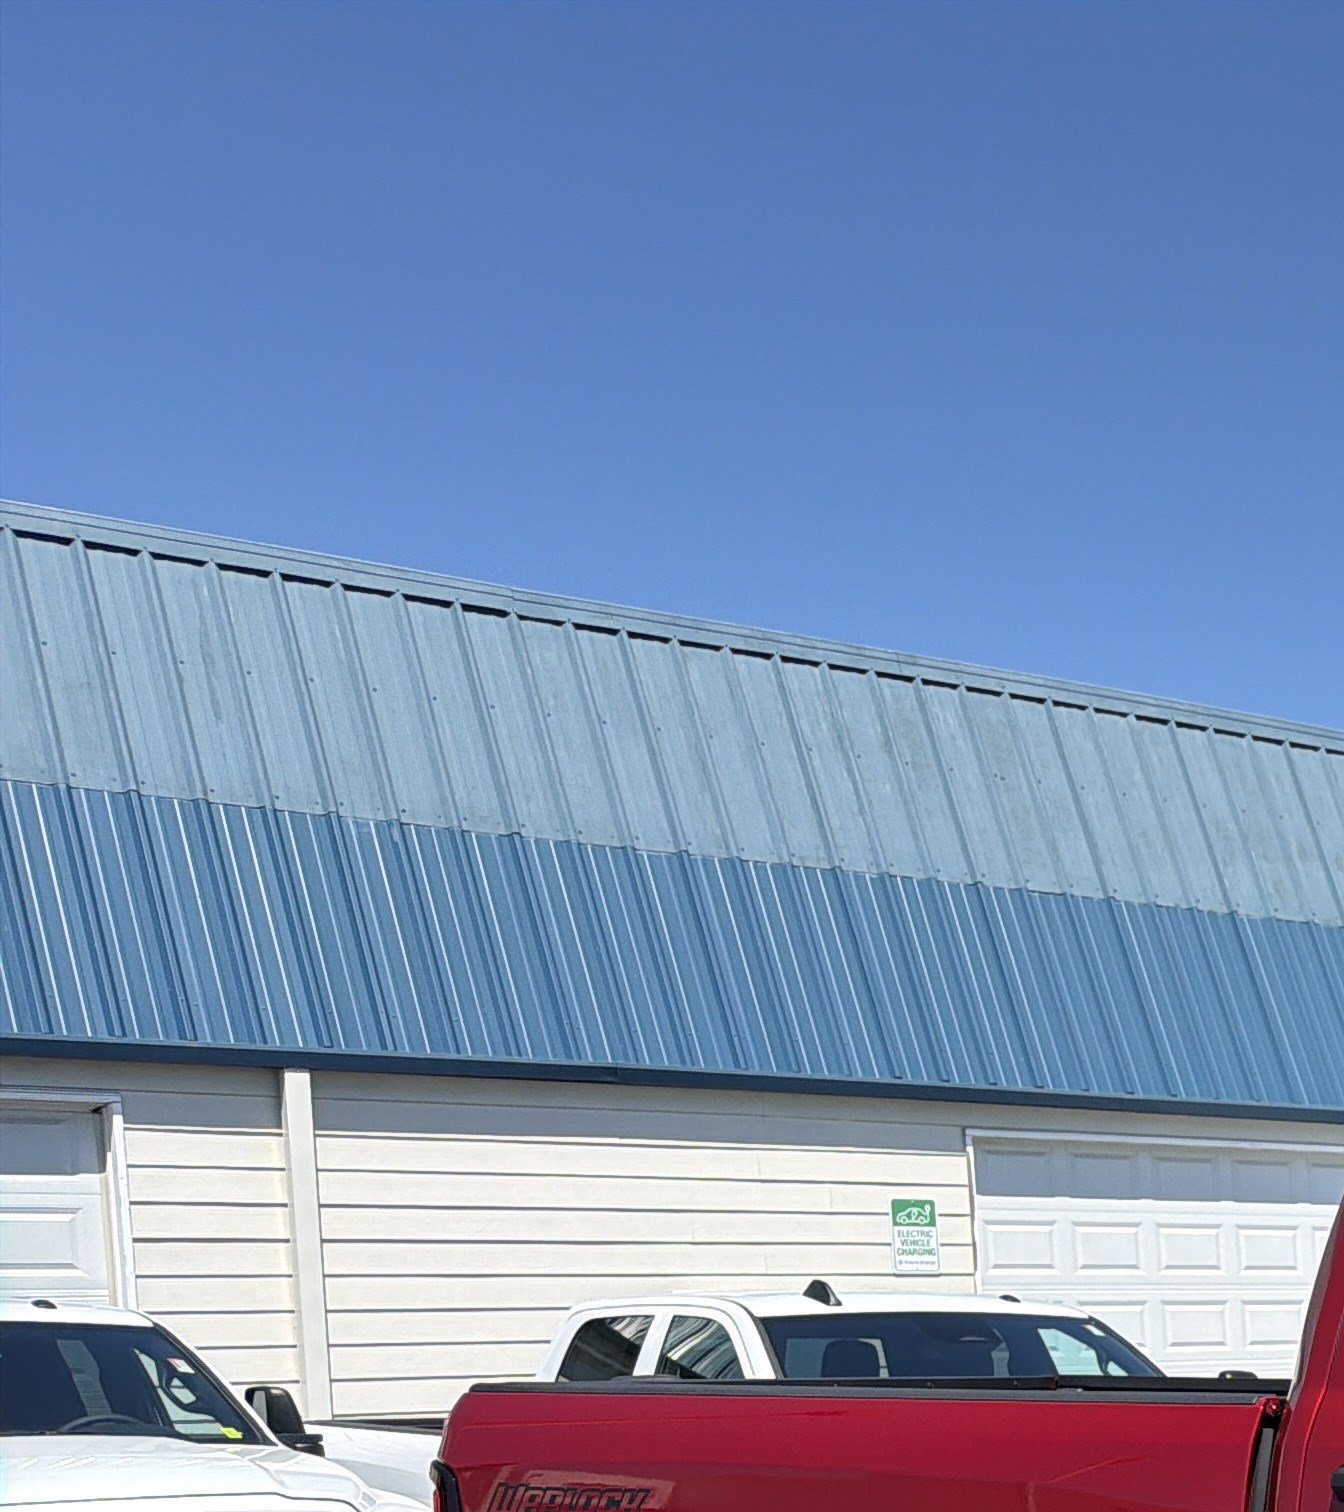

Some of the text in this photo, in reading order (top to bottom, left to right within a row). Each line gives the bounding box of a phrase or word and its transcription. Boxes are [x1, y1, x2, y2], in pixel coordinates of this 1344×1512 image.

[897, 1229, 934, 1238] ELECTRIC
[900, 1238, 931, 1247] VEHICLE
[896, 1247, 936, 1256] CHARGING
